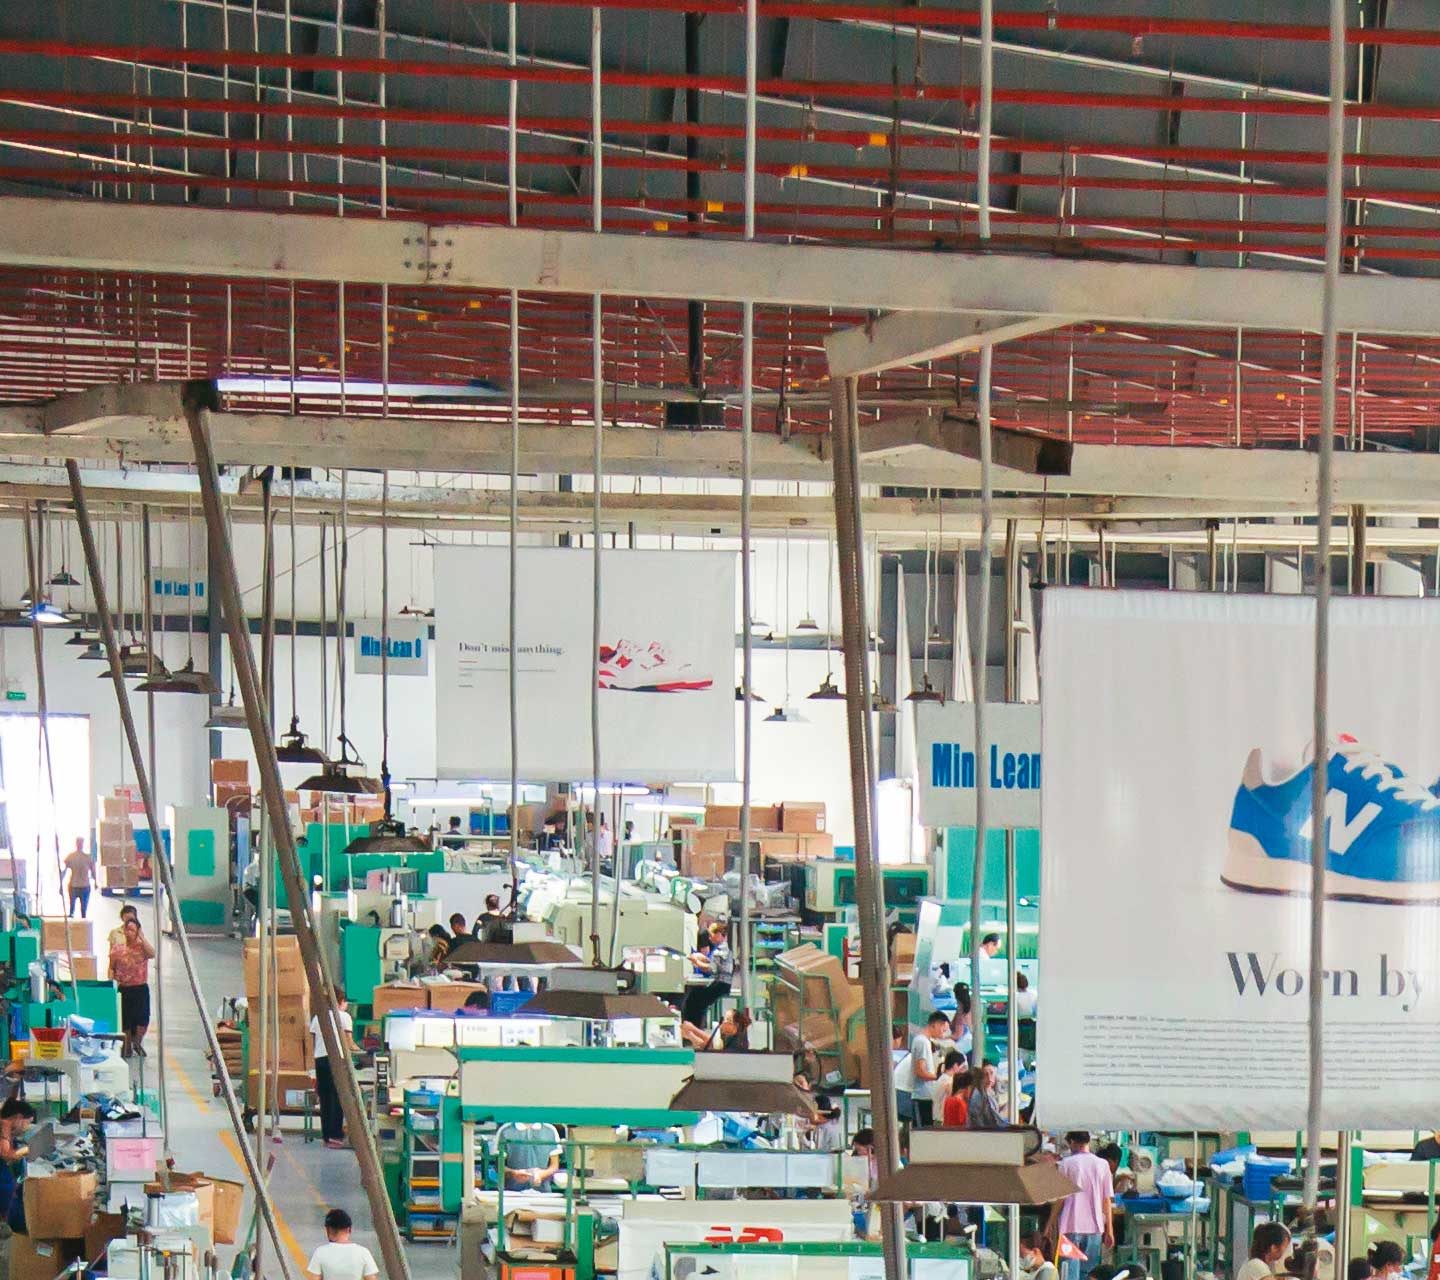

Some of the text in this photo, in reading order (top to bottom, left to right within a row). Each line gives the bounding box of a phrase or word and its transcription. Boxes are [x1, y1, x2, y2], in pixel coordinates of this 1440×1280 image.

[360, 635, 384, 657] Min
[491, 643, 515, 653] mis
[930, 742, 1041, 789] Min Lean
[1377, 952, 1424, 1013] by
